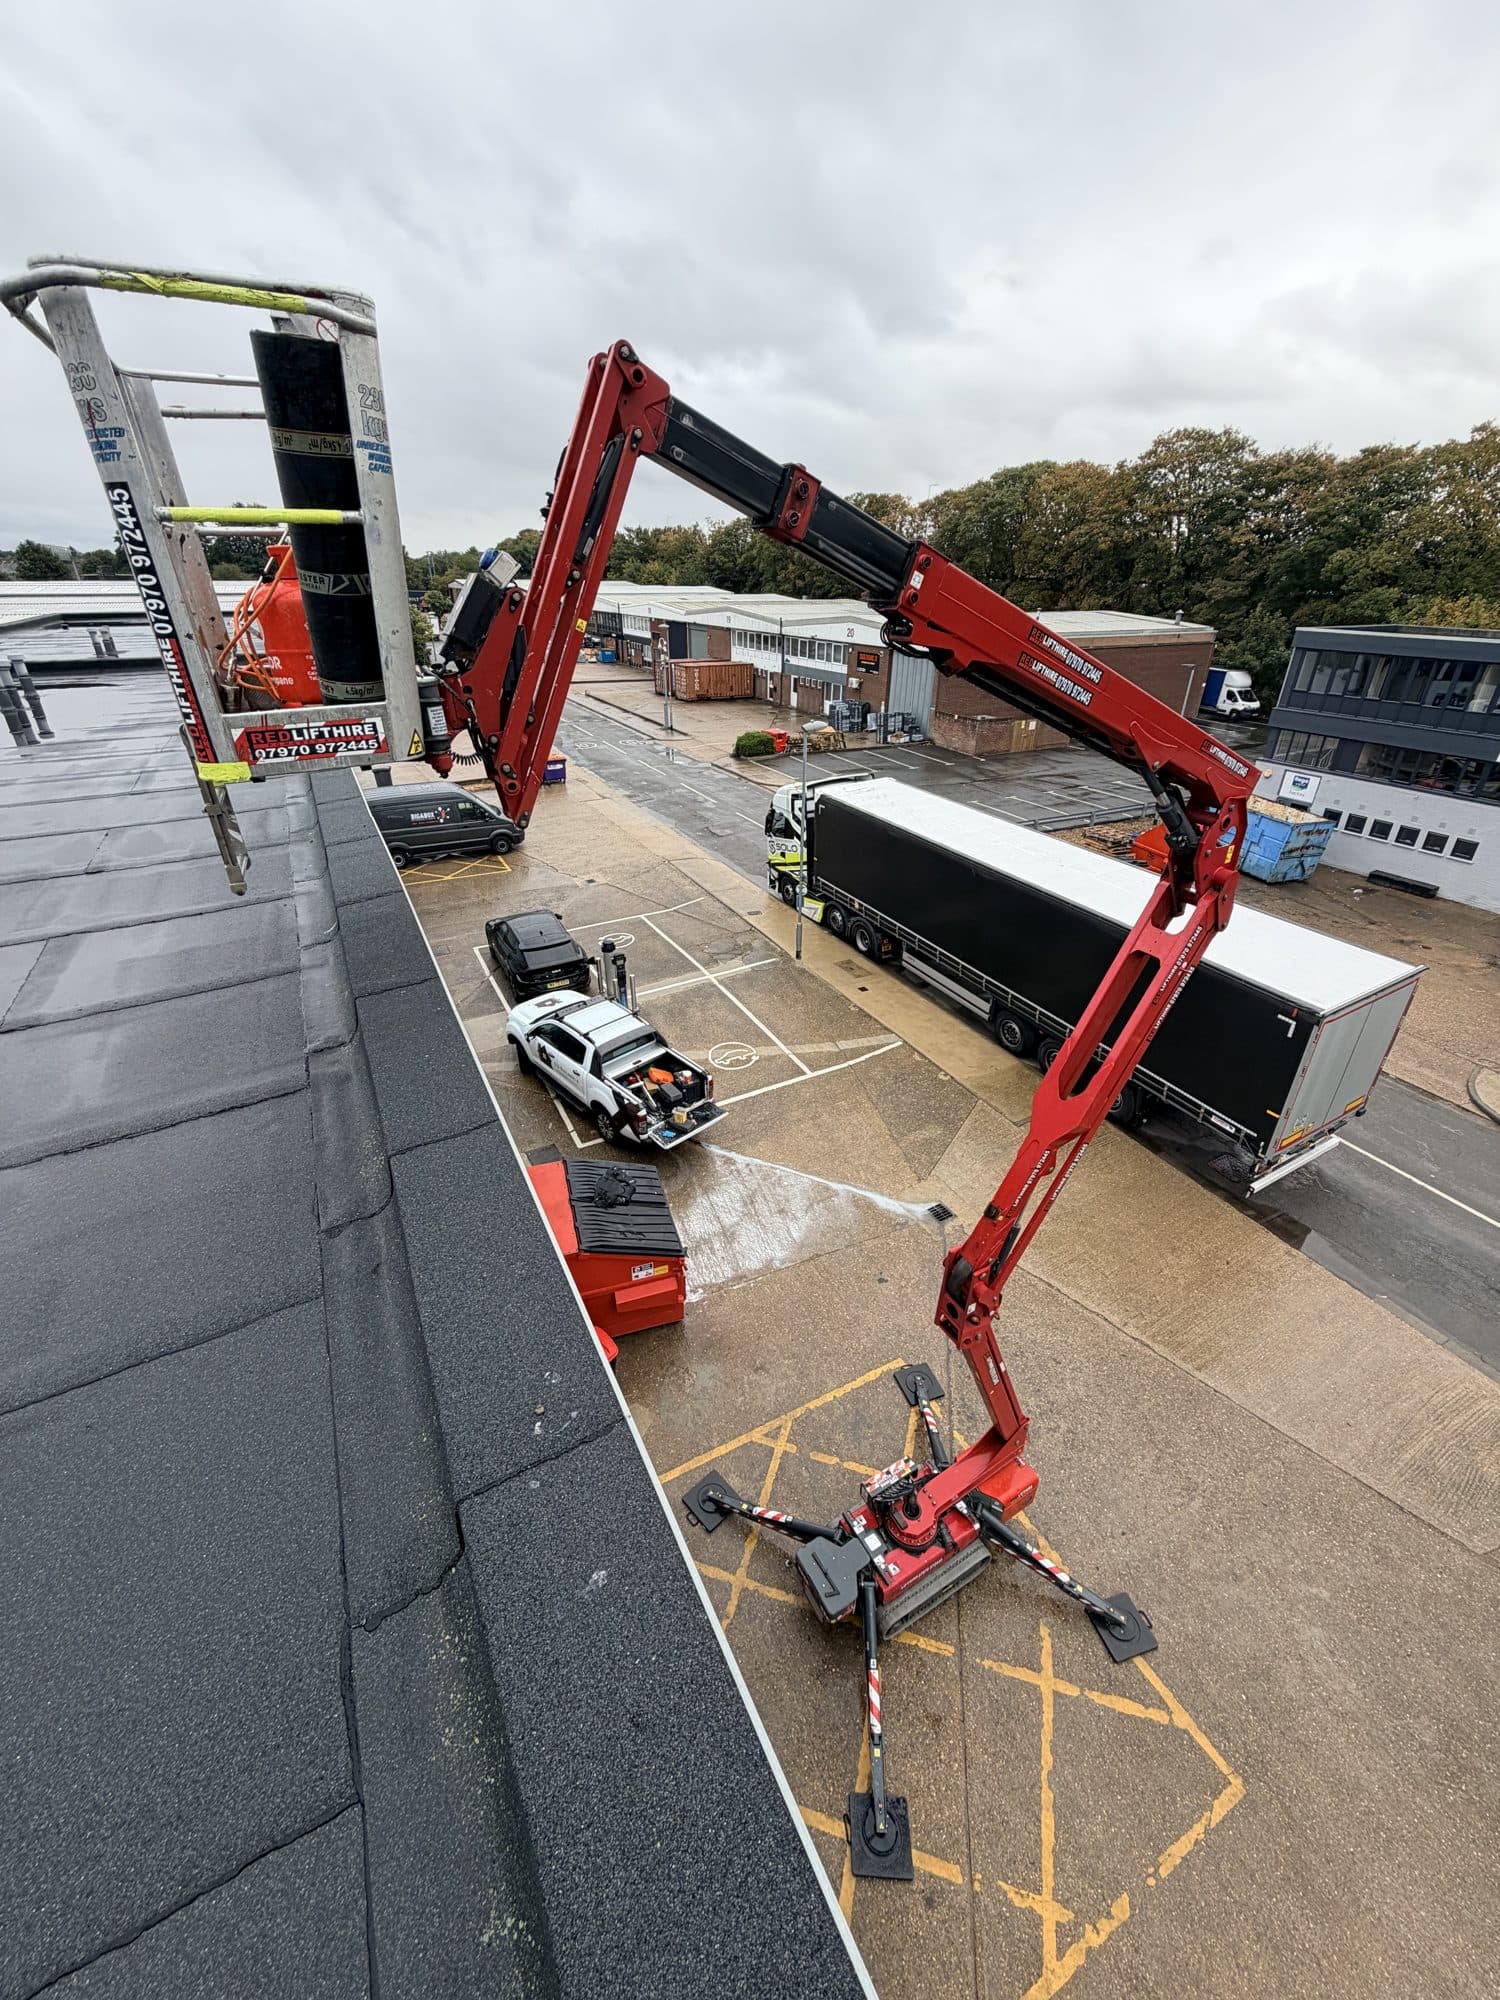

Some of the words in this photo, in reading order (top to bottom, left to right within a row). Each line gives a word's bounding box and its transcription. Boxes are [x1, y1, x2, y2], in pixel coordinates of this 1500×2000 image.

[108, 487, 150, 568] 972445
[139, 575, 173, 635] 07970
[847, 627, 855, 638] 20
[255, 745, 310, 759] 07970
[315, 739, 379, 754] 972445
[776, 842, 798, 852] SOLO
